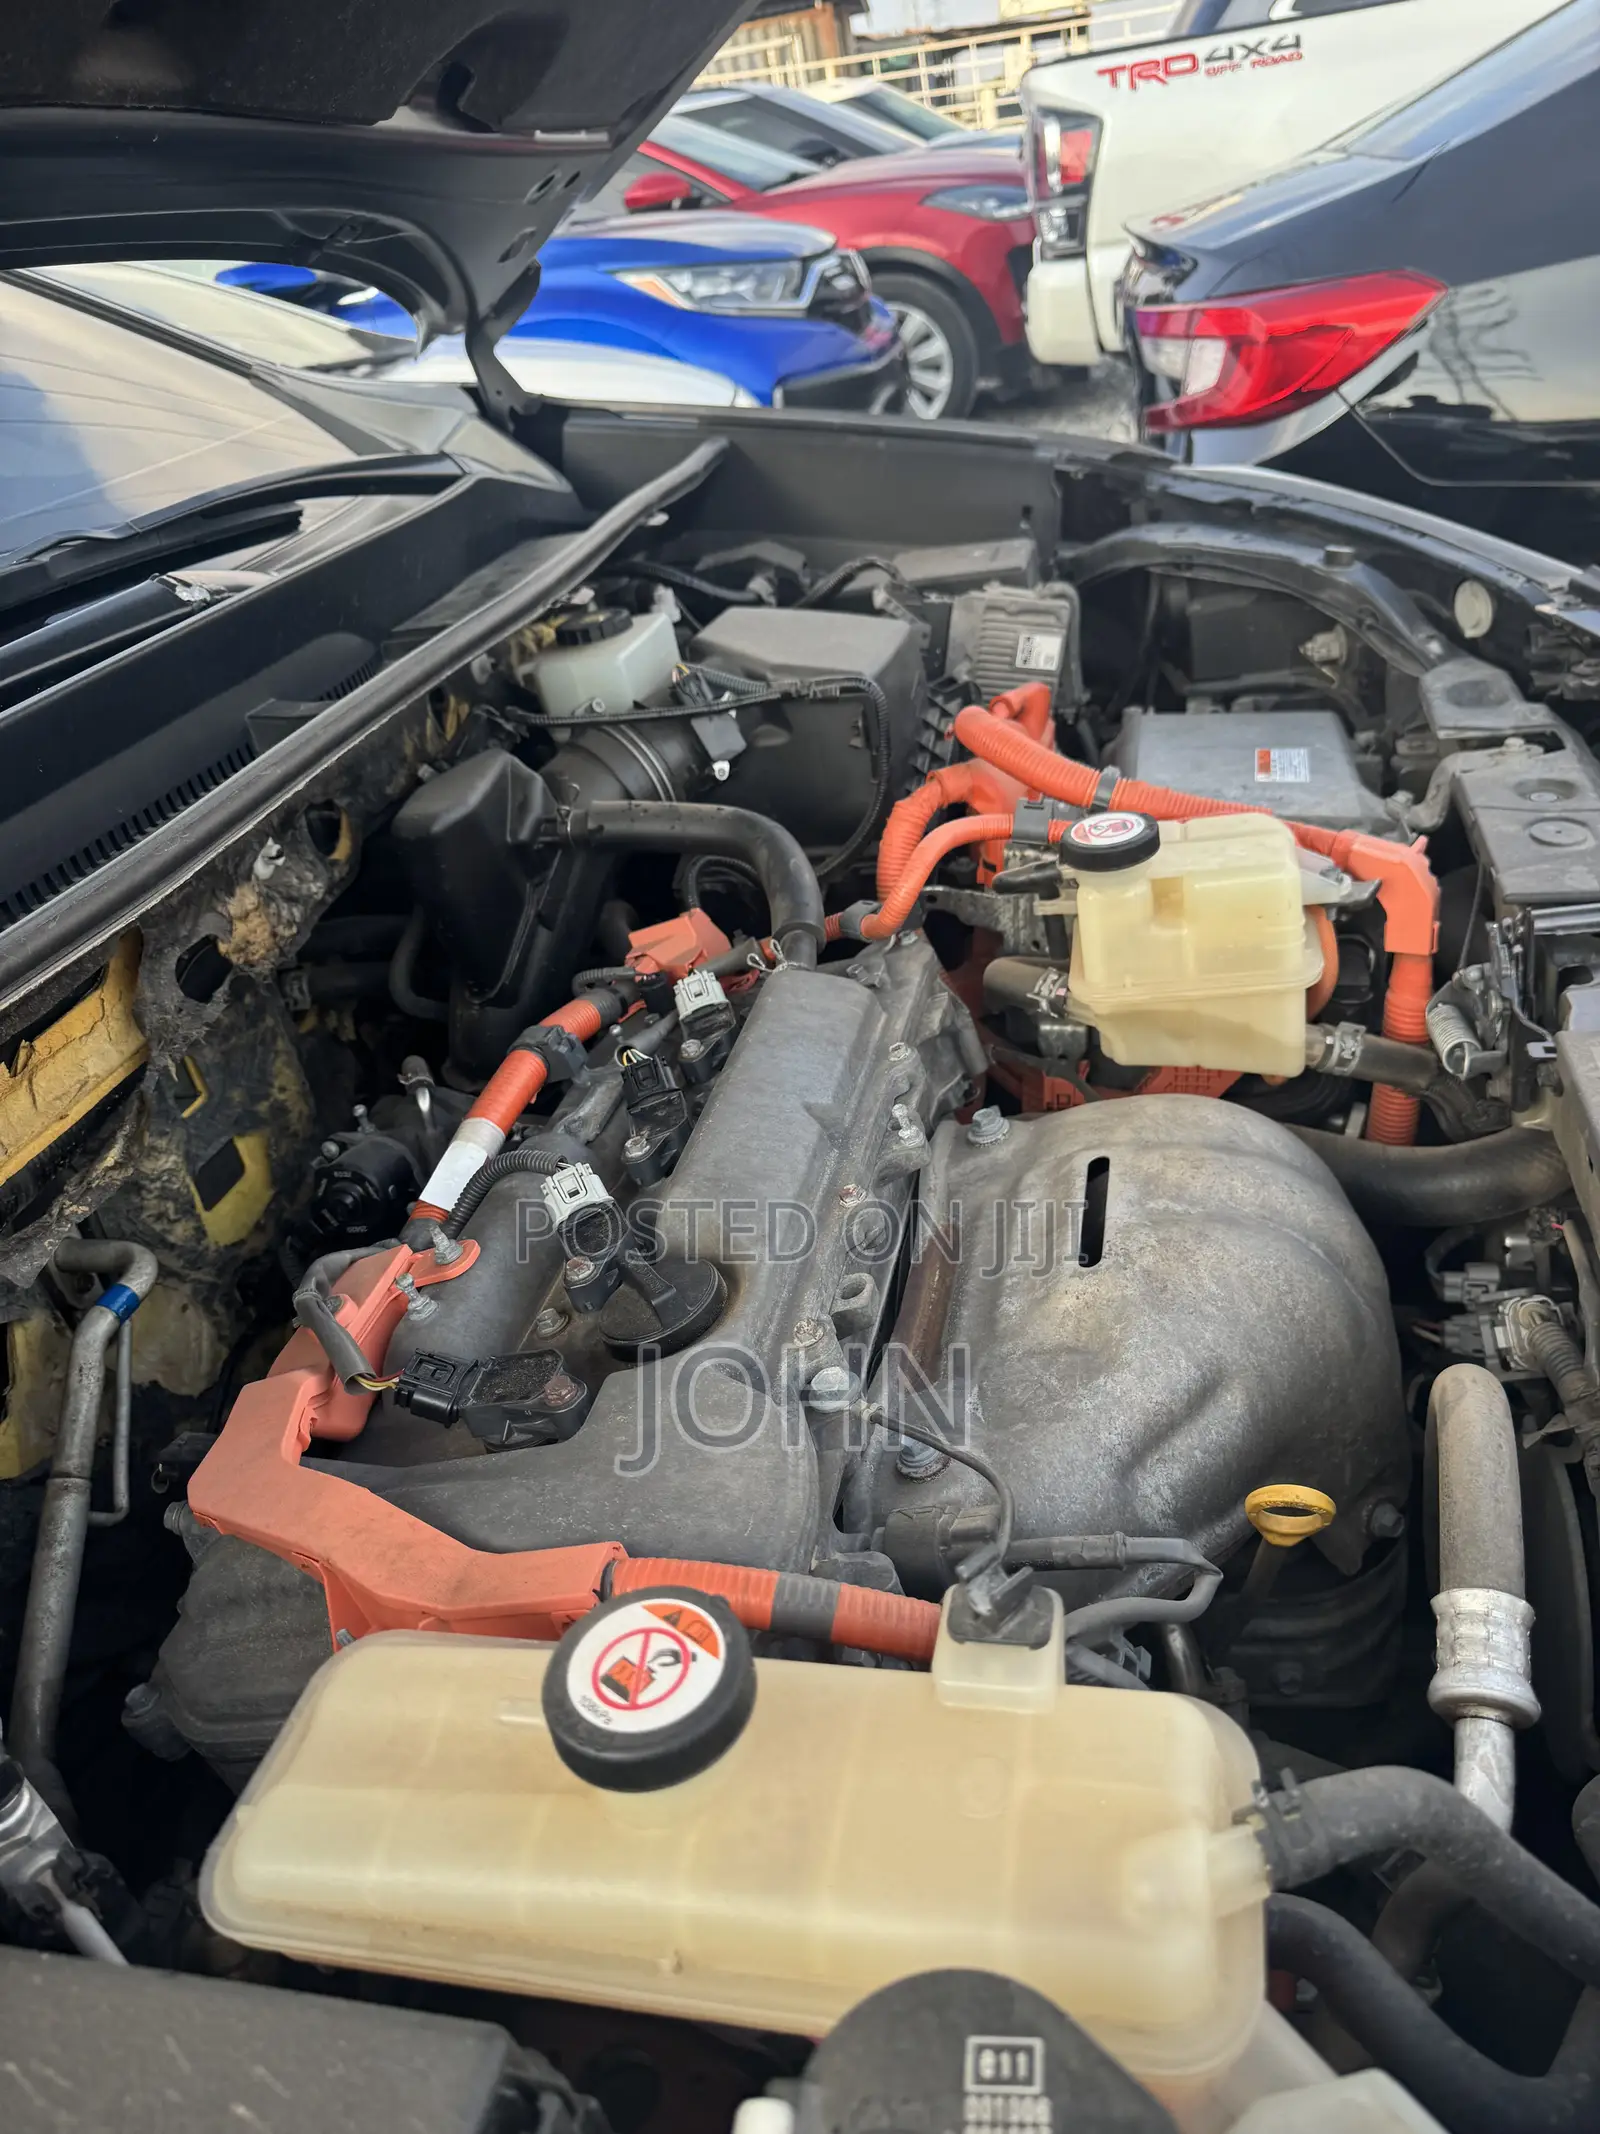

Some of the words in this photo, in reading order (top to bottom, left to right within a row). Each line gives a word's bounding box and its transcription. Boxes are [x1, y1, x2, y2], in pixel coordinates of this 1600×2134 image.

[1096, 52, 1199, 91] TRD
[1204, 60, 1242, 78] OFF
[1251, 50, 1304, 70] ROAD
